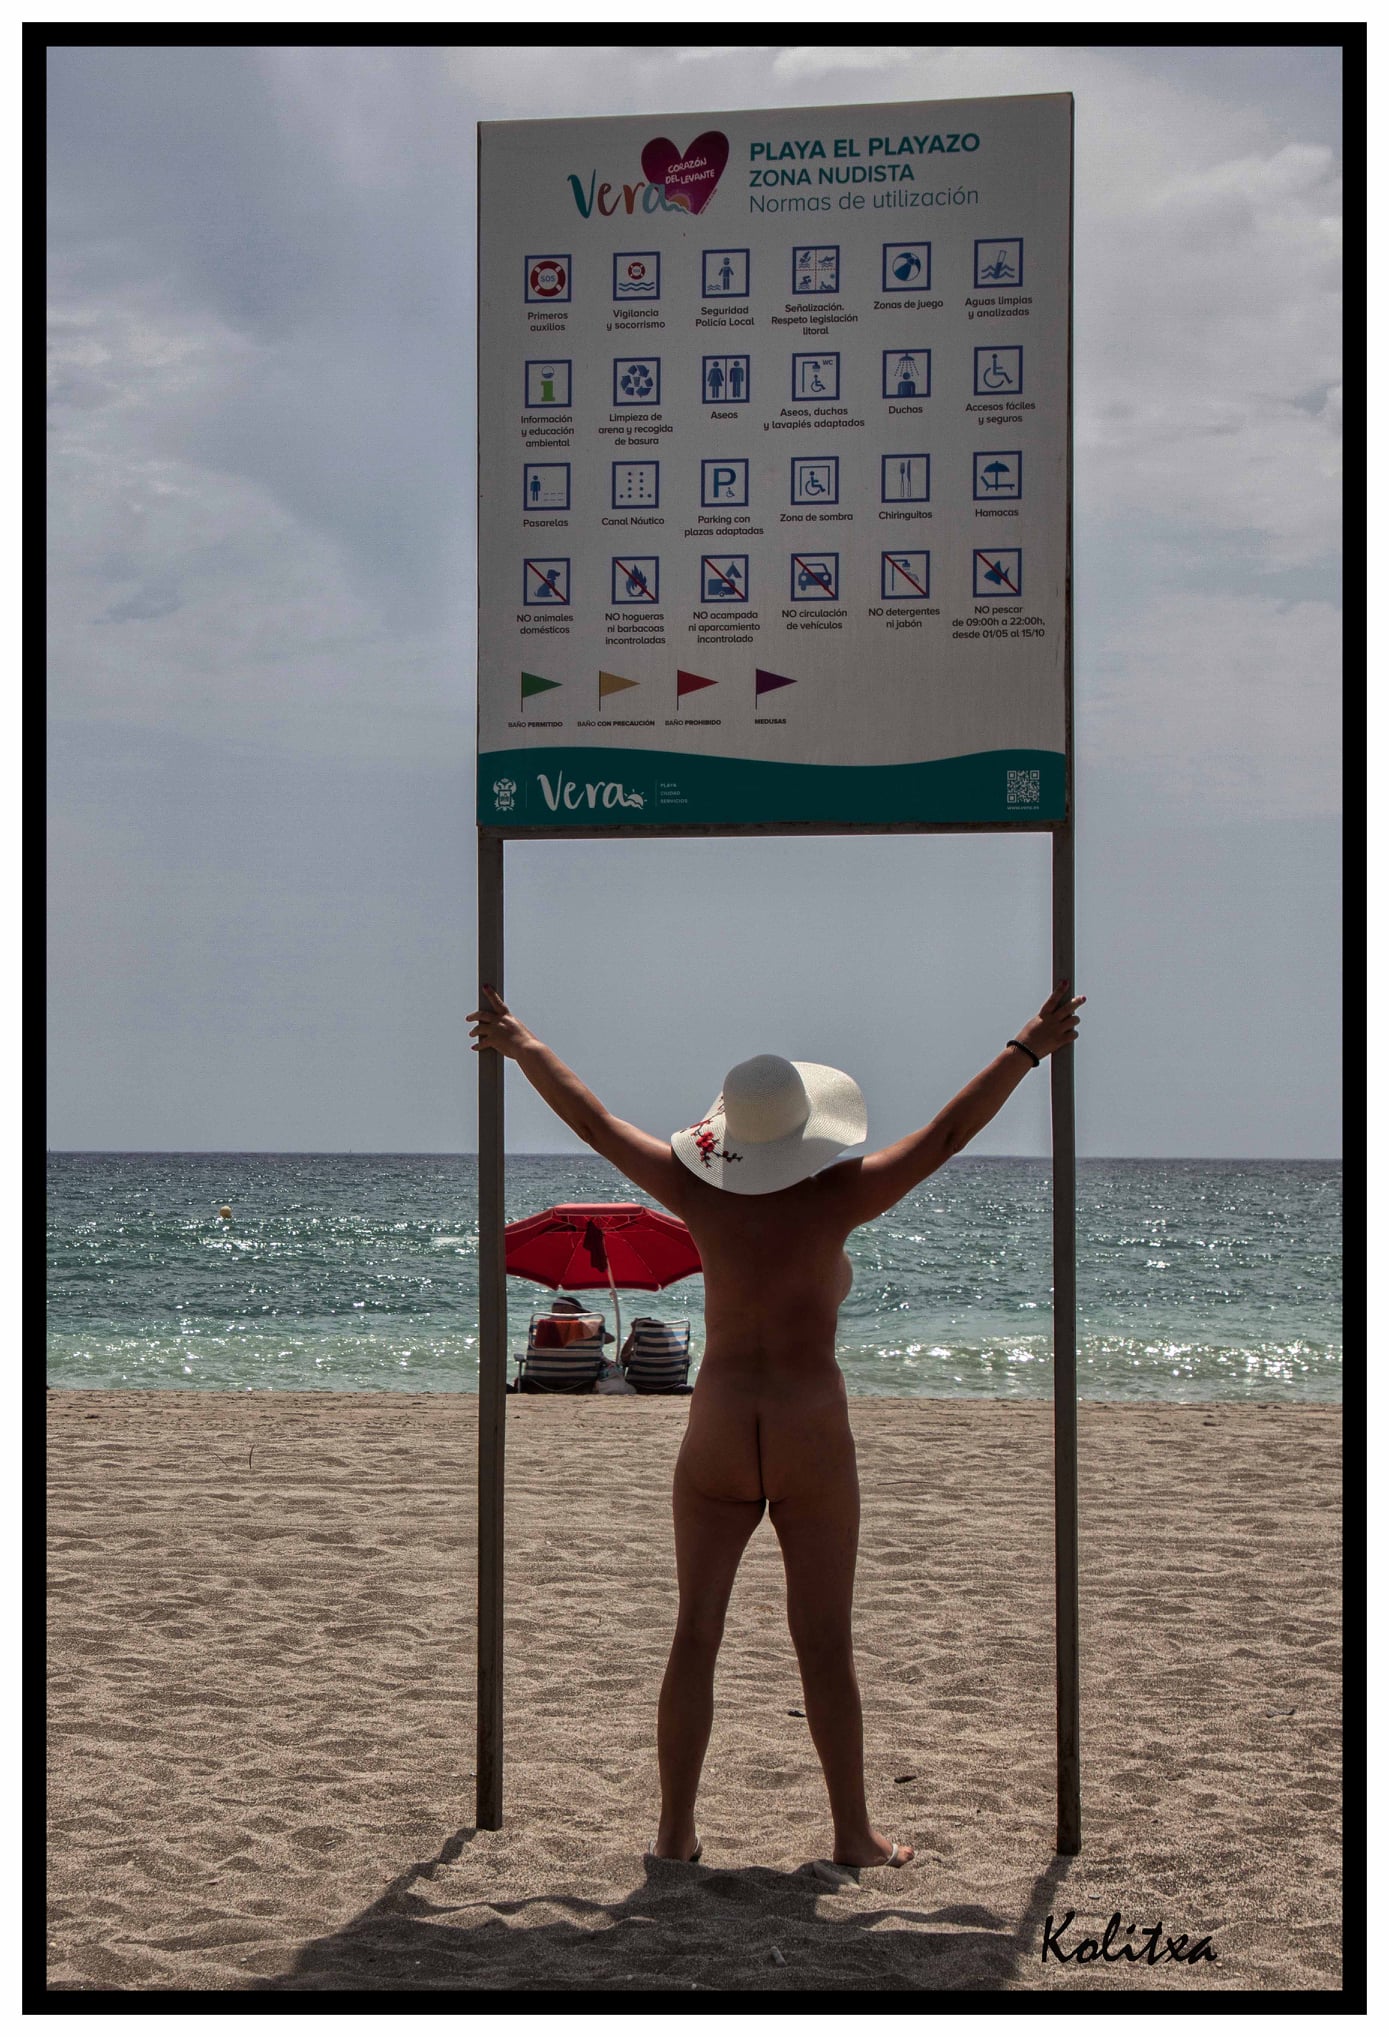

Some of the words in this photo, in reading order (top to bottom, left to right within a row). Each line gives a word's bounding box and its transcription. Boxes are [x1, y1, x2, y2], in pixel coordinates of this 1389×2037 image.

[750, 141, 826, 161] PLAYA
[834, 138, 860, 158] EL
[869, 133, 980, 156] PLAYAZO
[667, 156, 707, 173] CORAZÓN
[665, 174, 680, 184] DEL
[680, 169, 715, 184] LEVANTE
[749, 168, 810, 187] ZONA
[819, 164, 915, 184] NUDISTA
[568, 169, 690, 219] Vera
[750, 193, 831, 213] Normas
[838, 192, 867, 210] de
[872, 187, 979, 208] utilización
[873, 300, 902, 310] Zonas
[904, 300, 916, 309] de
[917, 299, 944, 311] juego
[965, 297, 996, 307] Aguas
[997, 295, 1033, 306] limpias
[700, 305, 749, 317] Seguridad
[785, 302, 845, 313] Señalización.
[527, 311, 568, 320] Primeros
[613, 308, 659, 319] Vigilancia
[967, 310, 975, 320] y
[976, 308, 1030, 317] analizadas
[606, 321, 613, 331] y
[614, 319, 666, 329] socorrismo
[695, 317, 727, 327] Policía
[729, 317, 755, 326] Local
[771, 315, 808, 326] Respeto
[809, 314, 858, 325] legislación
[530, 322, 566, 332] auxilios
[802, 326, 829, 336] litoral
[780, 407, 812, 418] Aseos,
[814, 406, 848, 416] duchas
[888, 405, 923, 415] Duchas
[965, 402, 1004, 413] Accesos
[1005, 401, 1036, 411] fáciles
[520, 414, 573, 424] Información
[609, 412, 649, 423] Limpieza
[650, 412, 663, 422] de
[710, 410, 739, 420] Aseos
[978, 415, 985, 425] y
[986, 413, 1023, 424] seguros
[598, 425, 625, 434] arena
[626, 426, 633, 436] y
[634, 424, 673, 435] recogida
[763, 421, 770, 431] y
[771, 419, 812, 430] lavapiés
[814, 418, 865, 429] adaptados
[521, 427, 527, 437] y
[528, 425, 575, 436] educación
[525, 437, 571, 448] ambiental
[614, 437, 626, 446] de
[627, 436, 659, 446] basura
[779, 513, 804, 522] Zona
[805, 512, 818, 522] de
[819, 512, 854, 521] sombra
[878, 510, 933, 522] Chiringuitos
[975, 508, 1019, 518] Hamacas
[523, 518, 569, 528] Pasarelas
[601, 517, 629, 526] Canal
[631, 516, 665, 525] Náutico
[697, 515, 732, 526] Parking
[733, 515, 751, 524] con
[684, 527, 714, 538] plazas
[715, 526, 764, 537] adaptadas
[692, 611, 708, 620] NO
[710, 611, 759, 621] acampada
[781, 609, 797, 618] NO
[799, 608, 848, 618] circulación
[868, 608, 884, 617] NO
[885, 607, 940, 618] detergentes
[974, 605, 990, 615] NO
[992, 606, 1025, 616] pescar
[516, 614, 532, 623] NO
[533, 613, 574, 622] animales
[605, 612, 620, 621] NO
[622, 612, 664, 623] hogueras
[952, 618, 965, 627] de
[966, 617, 999, 627] 09:00h
[520, 625, 570, 635] domésticos
[607, 624, 616, 633] ni
[618, 624, 665, 633] barbacoas
[688, 623, 697, 632] ni
[698, 623, 761, 633] aparcamiento
[786, 621, 799, 630] de
[800, 620, 843, 630] vehículos
[886, 619, 895, 628] ni
[895, 619, 922, 630] jabón
[697, 634, 754, 644] incontrolado
[952, 630, 981, 639] desde
[982, 629, 1008, 639] 01/05
[1010, 629, 1020, 638] al
[1021, 628, 1045, 639] 15/10
[605, 635, 666, 645] incontroladas
[613, 719, 656, 727] PRECAUCIÓN
[537, 769, 644, 812] Vera
